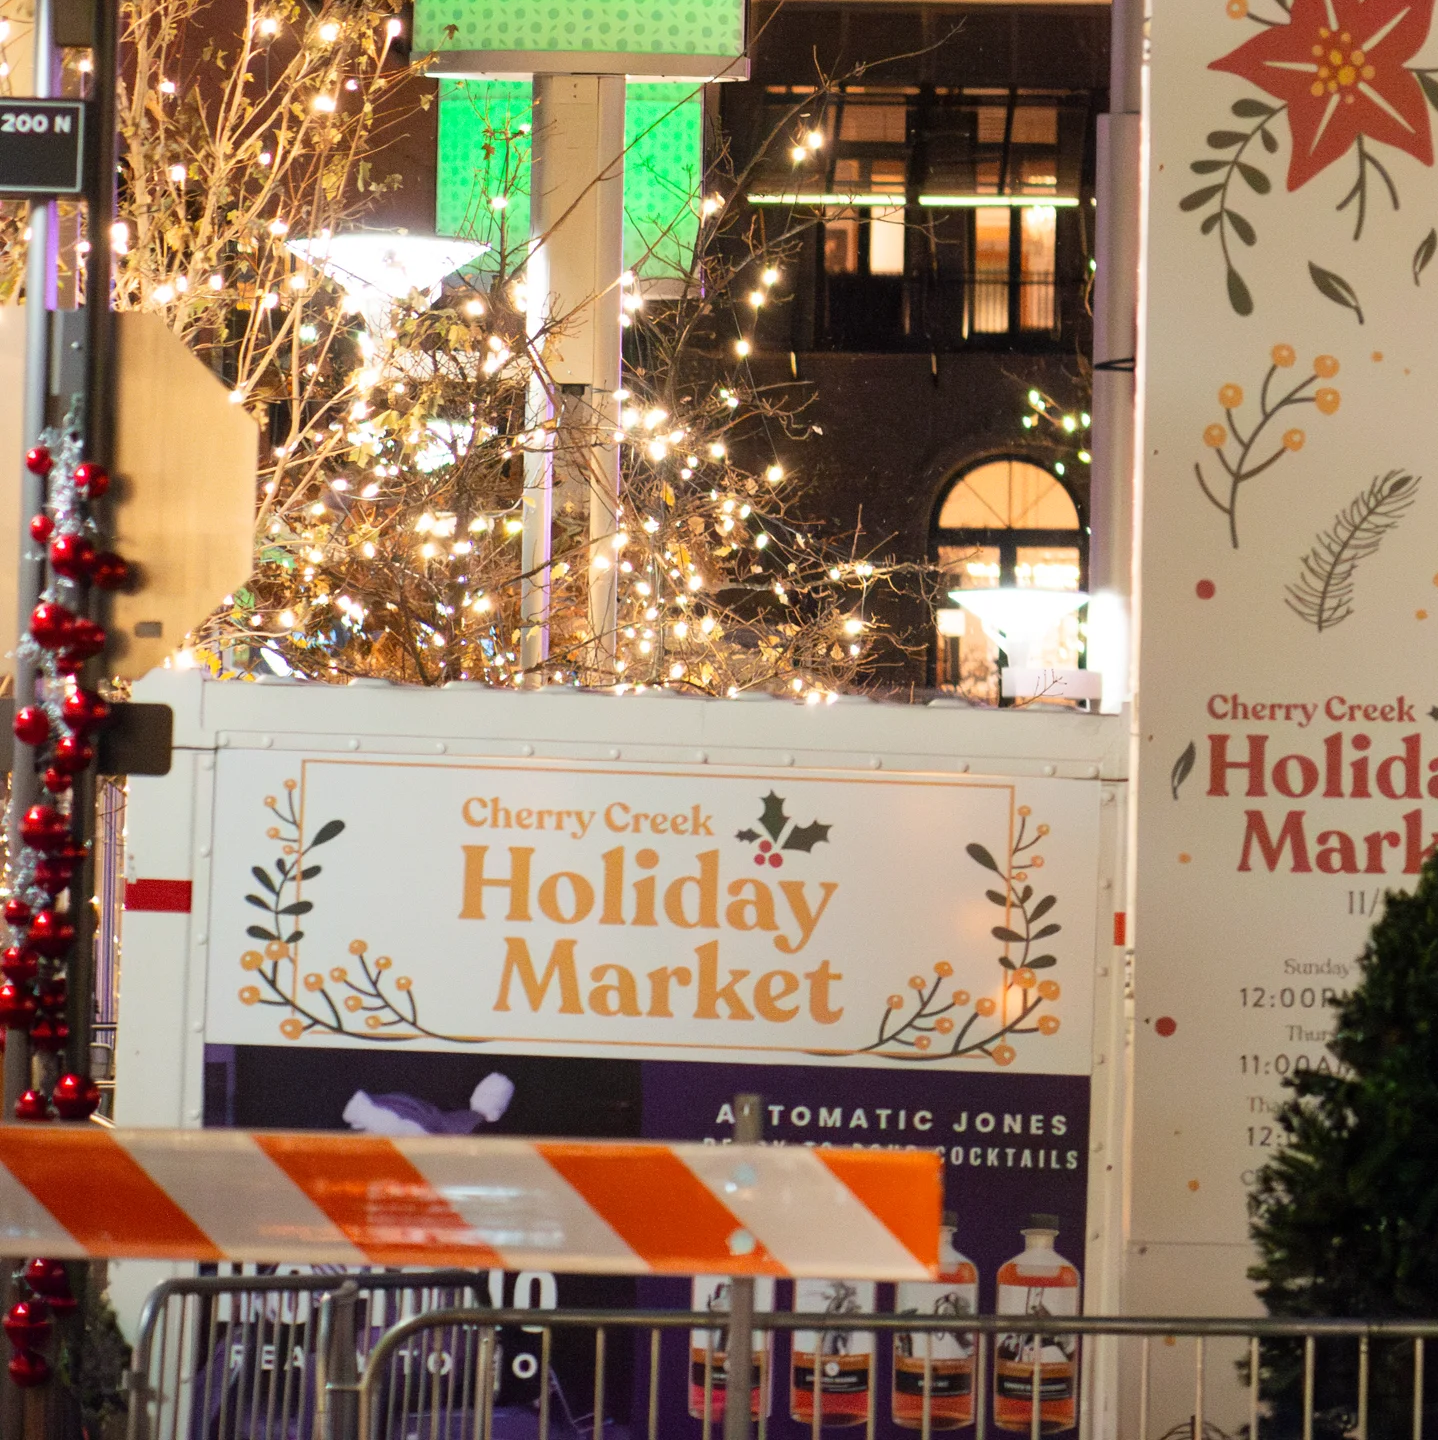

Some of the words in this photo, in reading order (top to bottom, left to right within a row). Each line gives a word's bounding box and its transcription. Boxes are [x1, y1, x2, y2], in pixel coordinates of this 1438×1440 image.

[54, 114, 72, 134] N
[1206, 693, 1319, 728] Cherry
[1324, 695, 1417, 723] Creek
[461, 796, 596, 840] Cherry
[603, 801, 715, 837] Creek
[458, 846, 840, 955] Holiday
[492, 938, 845, 1025] Market
[715, 1103, 933, 1132] ATOMATIC
[952, 1112, 1069, 1136] JONES
